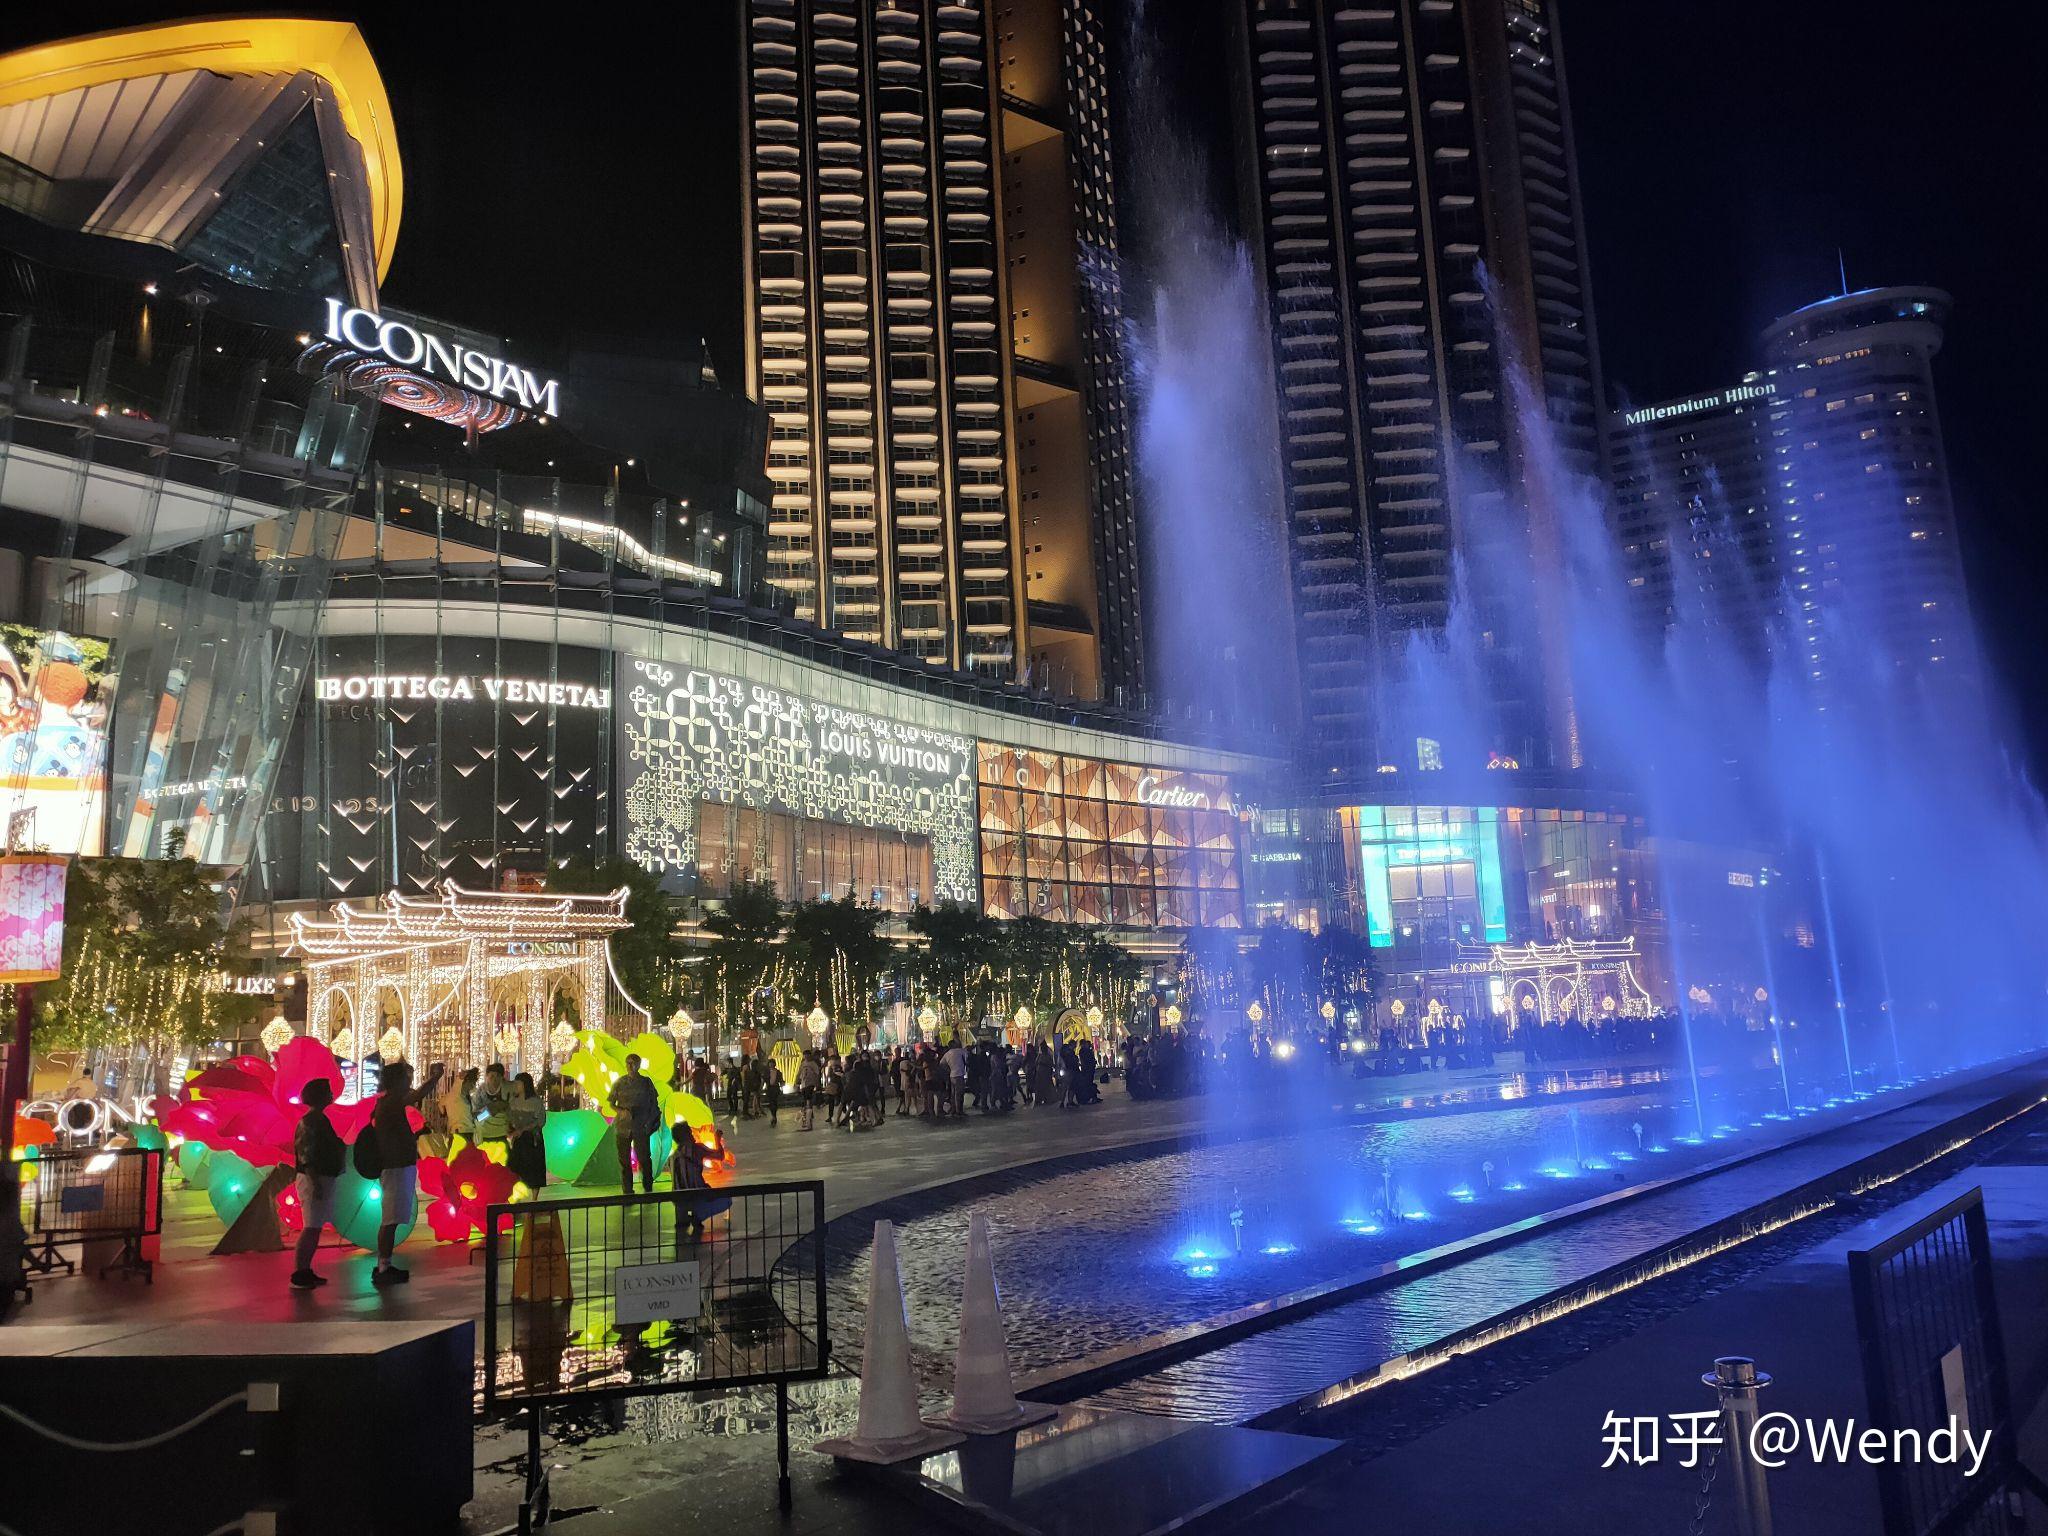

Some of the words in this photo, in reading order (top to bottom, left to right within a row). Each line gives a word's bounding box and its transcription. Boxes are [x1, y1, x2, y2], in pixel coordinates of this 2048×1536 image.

[324, 297, 559, 417] ICONSIAM
[1624, 393, 1721, 426] Millennium
[1725, 382, 1777, 405] Hilton
[318, 676, 474, 700] BOTTEGA
[482, 678, 604, 709] VENETA
[819, 727, 872, 759] LOUIS
[877, 743, 951, 775] VUITTON
[1137, 776, 1205, 808] Cartier
[507, 941, 577, 955] ICONSIAM
[648, 1301, 670, 1311] VMD
